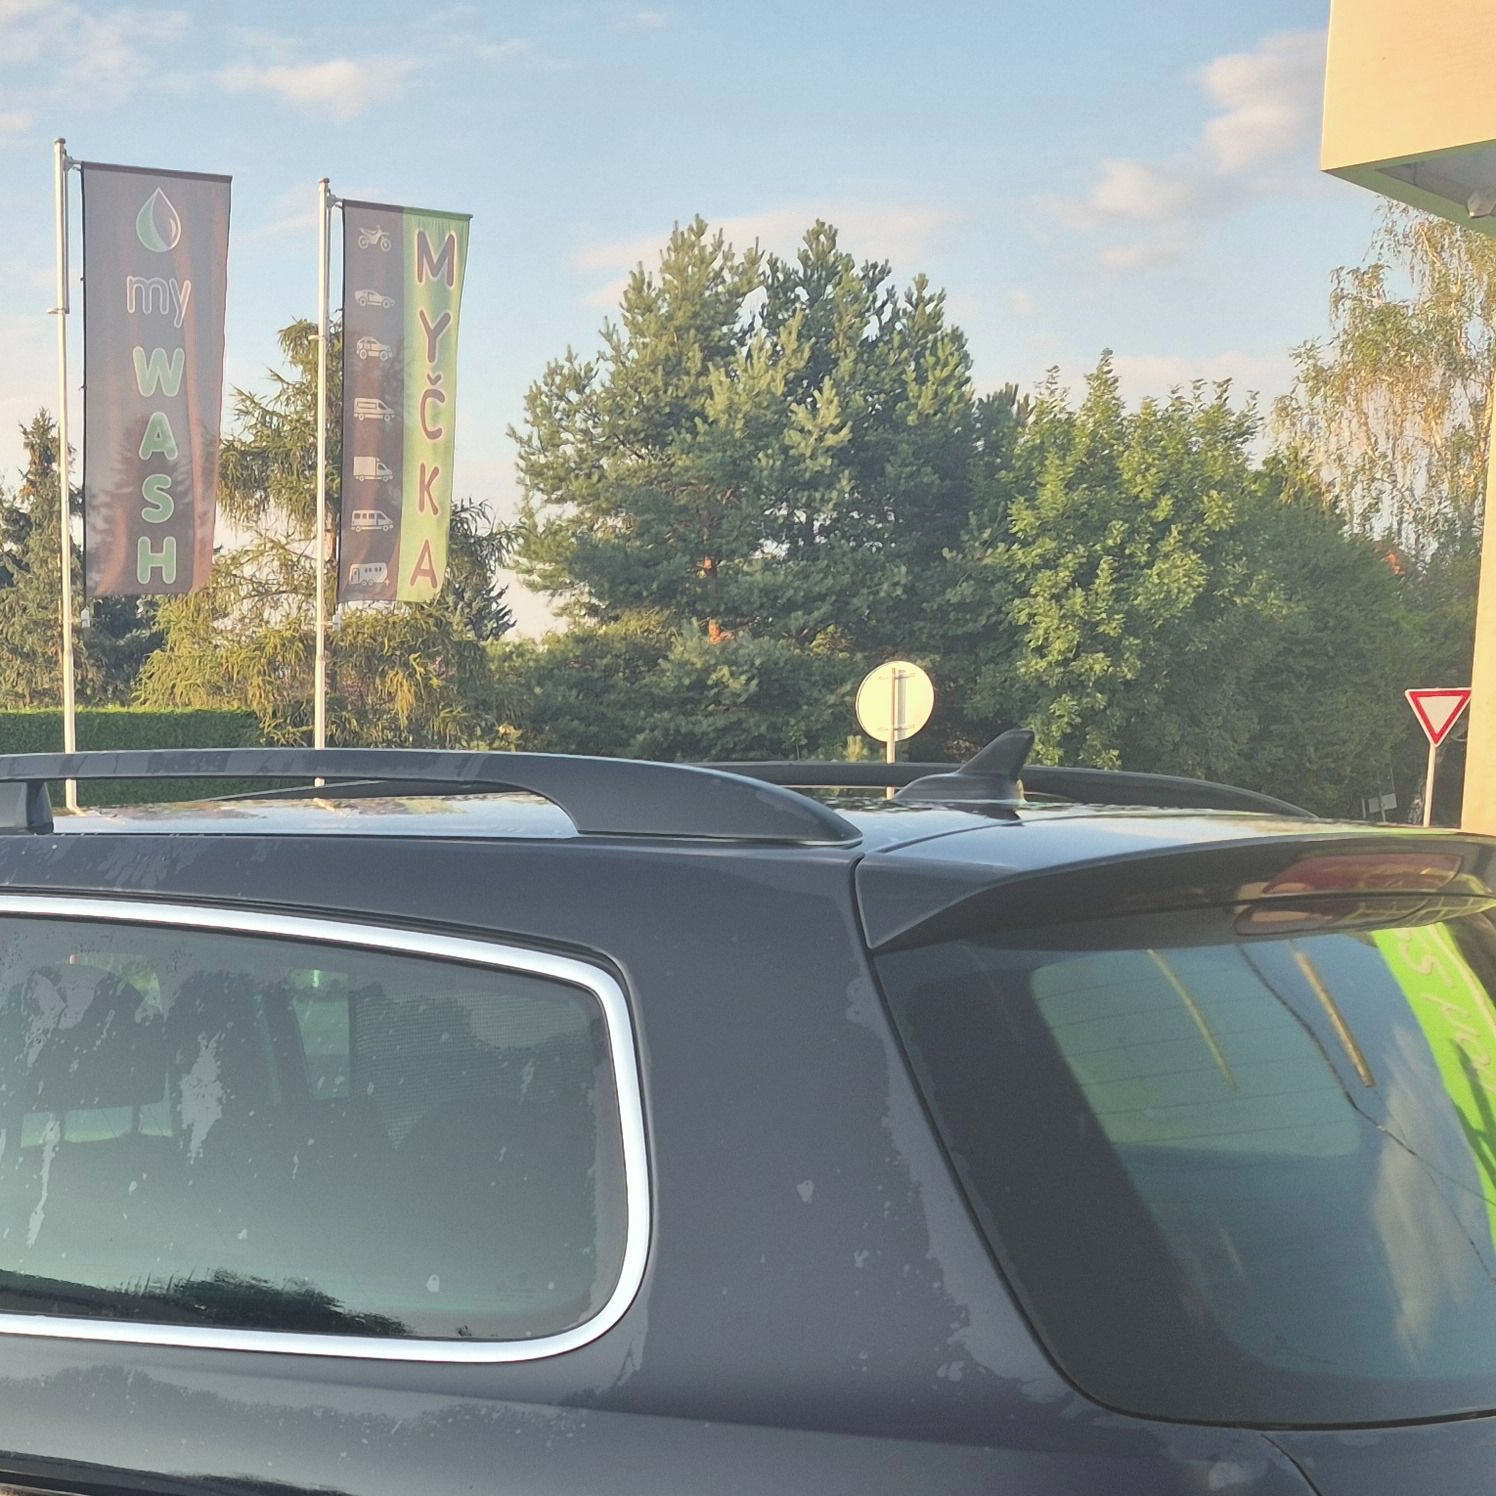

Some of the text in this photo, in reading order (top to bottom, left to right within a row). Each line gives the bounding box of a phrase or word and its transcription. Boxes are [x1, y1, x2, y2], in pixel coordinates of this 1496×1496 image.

[126, 275, 191, 328] my
[408, 228, 456, 591] MYČKA
[132, 346, 185, 584] WASH
